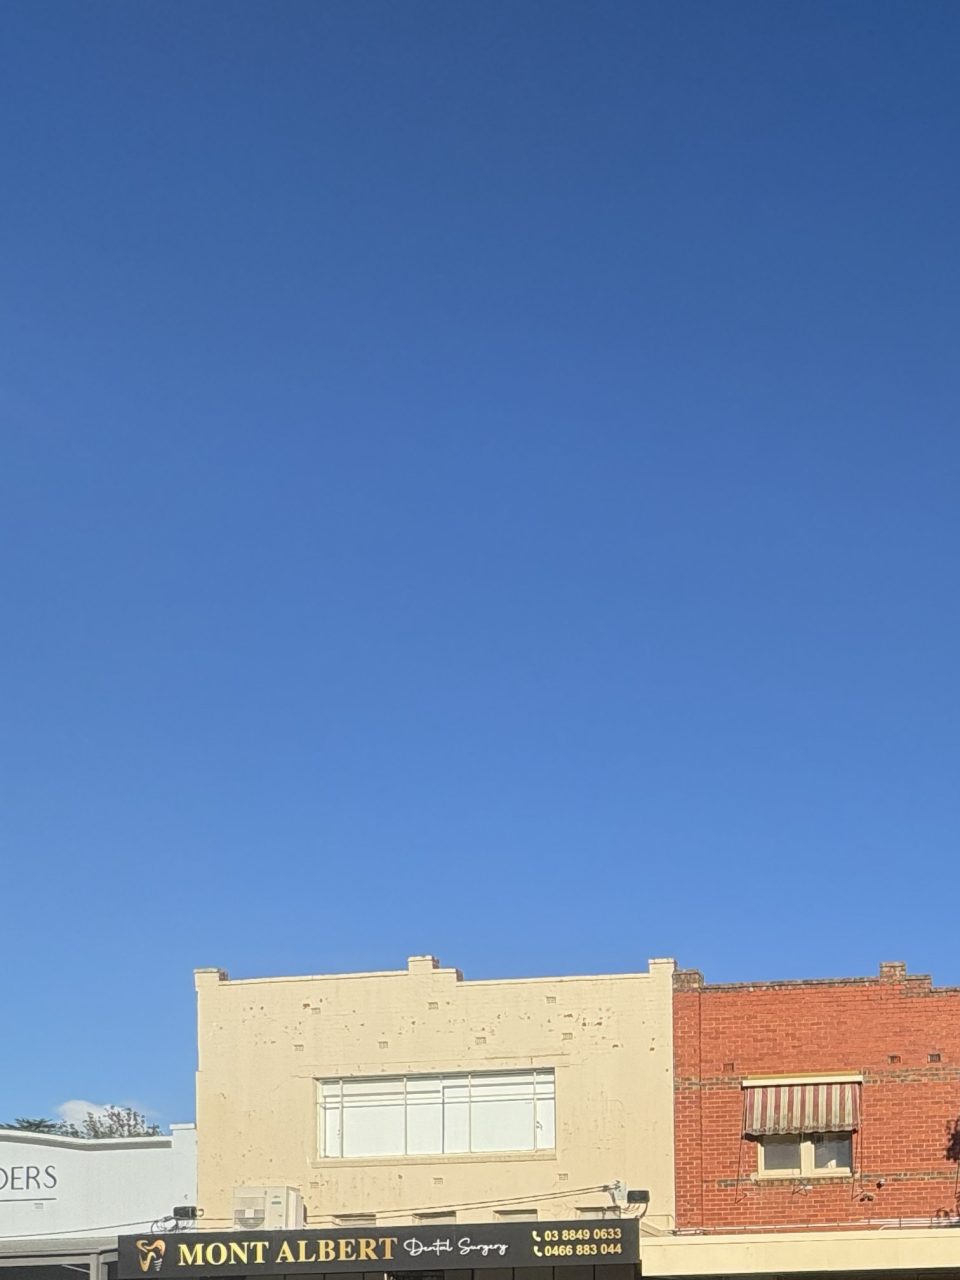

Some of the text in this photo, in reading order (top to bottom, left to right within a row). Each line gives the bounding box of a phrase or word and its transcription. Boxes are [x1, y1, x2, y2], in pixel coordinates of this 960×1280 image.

[544, 1228, 622, 1242] 03 8849 0633
[178, 1237, 508, 1266] MONT ALBERT Dental Surgery
[544, 1243, 622, 1257] 0466 883 044
